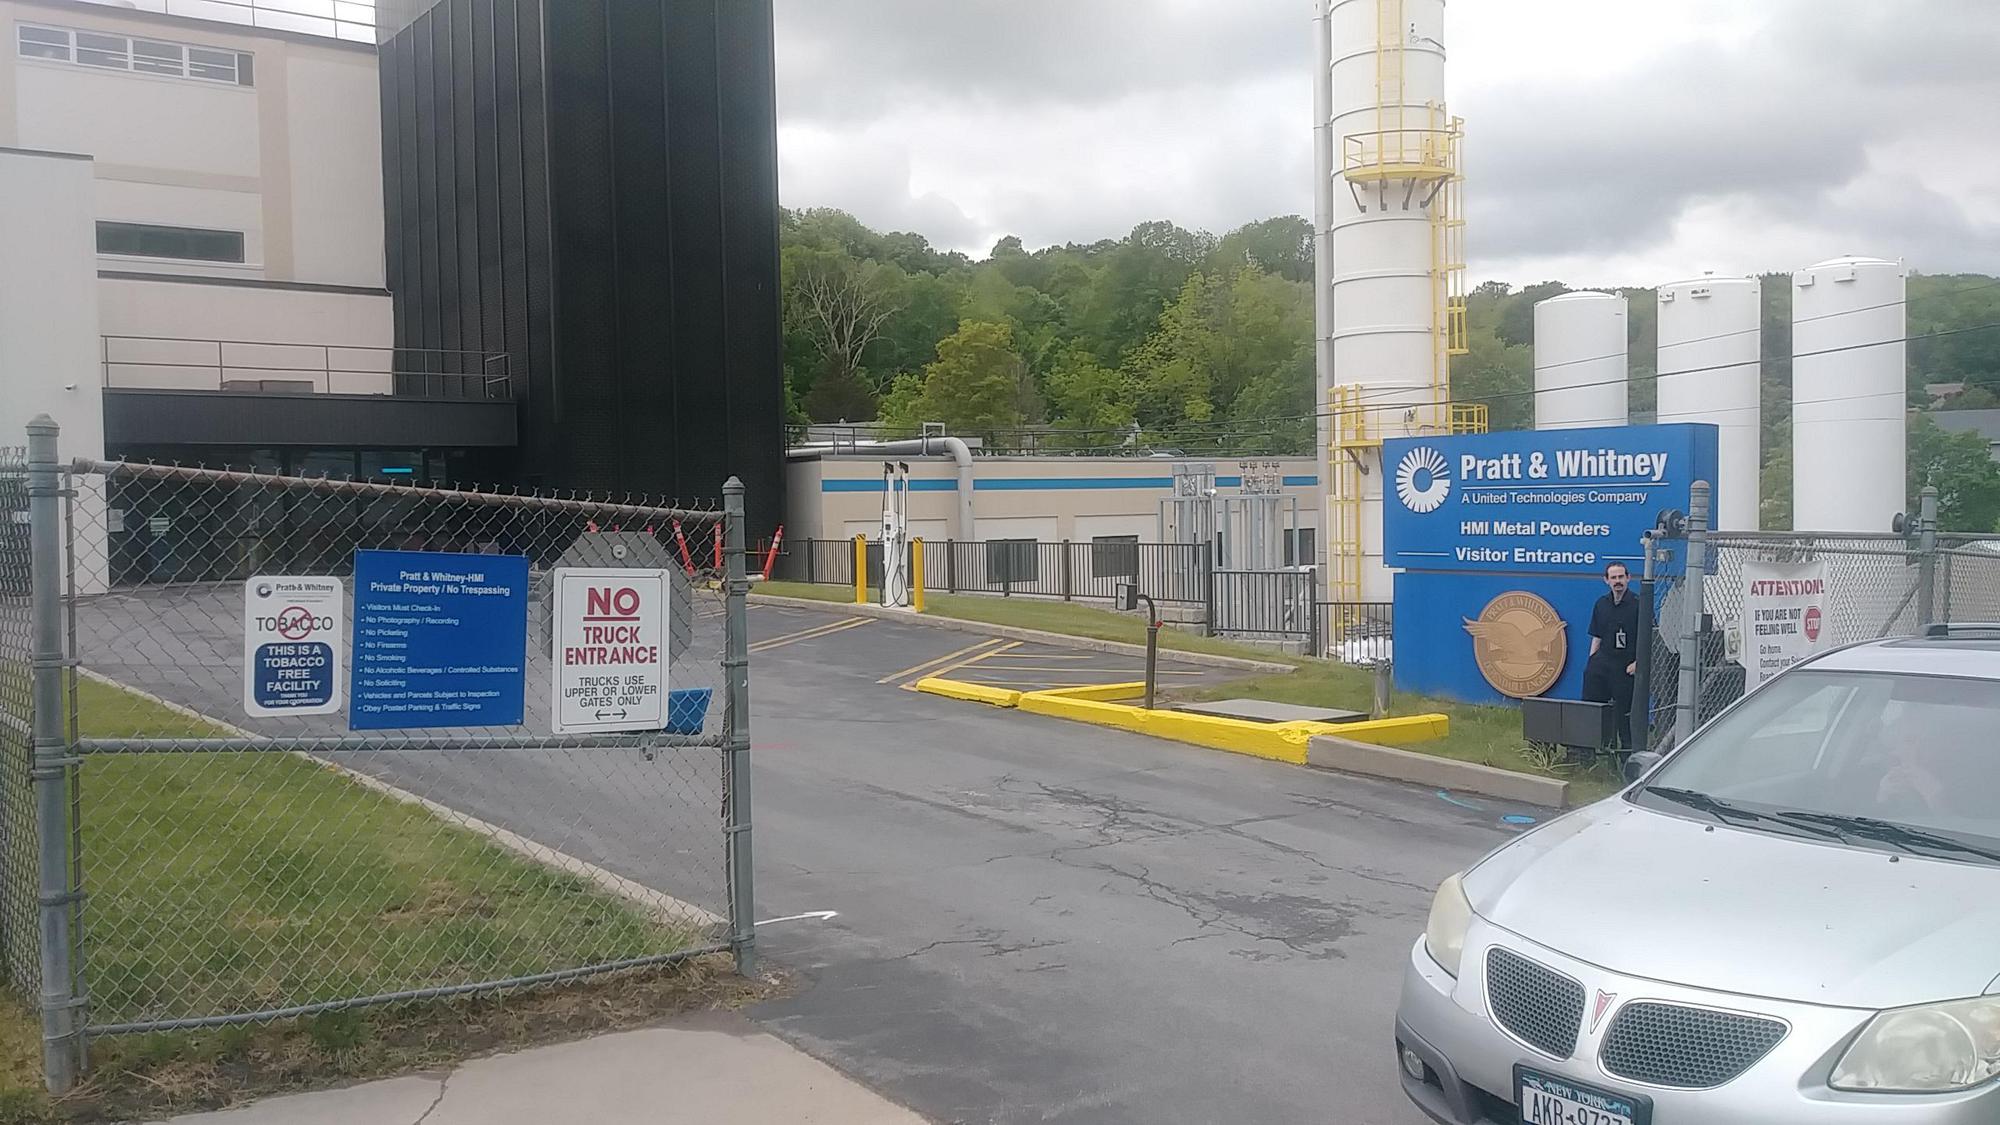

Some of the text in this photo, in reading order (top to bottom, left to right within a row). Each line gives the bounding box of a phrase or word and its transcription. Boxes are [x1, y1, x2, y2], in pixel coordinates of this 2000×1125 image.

[1459, 448, 1669, 482] Pratt & Whitney
[1461, 490, 1648, 506] A United Technologies Company
[1460, 520, 1610, 537] HMI Metal Powders
[1455, 546, 1596, 564] Visitor Entrance
[400, 571, 484, 584] Pratt & Whitney-HMI
[304, 583, 335, 593] Whitney
[370, 582, 401, 592] Private
[402, 583, 441, 596] Property
[446, 585, 459, 594] No
[461, 585, 511, 597] Trespassing
[1750, 579, 1825, 597] ATTENTION!
[587, 587, 640, 615] NO
[377, 616, 420, 626] Photography
[425, 617, 459, 626] Recording
[1754, 608, 1802, 621] IF YOU ARE NOT
[255, 616, 334, 632] TOBACCO
[1755, 622, 1798, 636] FEELING WELL
[583, 626, 640, 645] TRUCK
[267, 645, 322, 656] THIS IS A
[565, 646, 658, 666] ENTRANCE
[263, 656, 325, 668] TOBACCO
[376, 654, 407, 663] Smoking
[277, 669, 311, 680] FREE
[375, 666, 406, 674] Alcoholic
[407, 666, 443, 675] Beverages
[266, 680, 321, 692] FACILITY
[363, 679, 375, 687] No
[579, 675, 645, 687] TRUCKS USE
[433, 691, 459, 700] Subject
[467, 690, 500, 699] Inspection
[564, 685, 657, 698] UPPER OR LOWER
[579, 695, 643, 708] GATES ONLY
[362, 705, 381, 714] Obey
[407, 704, 434, 713] Parking
[441, 703, 462, 711] Traffic
[462, 703, 482, 711] Signs
[1546, 1081, 1608, 1110] NEW YORK
